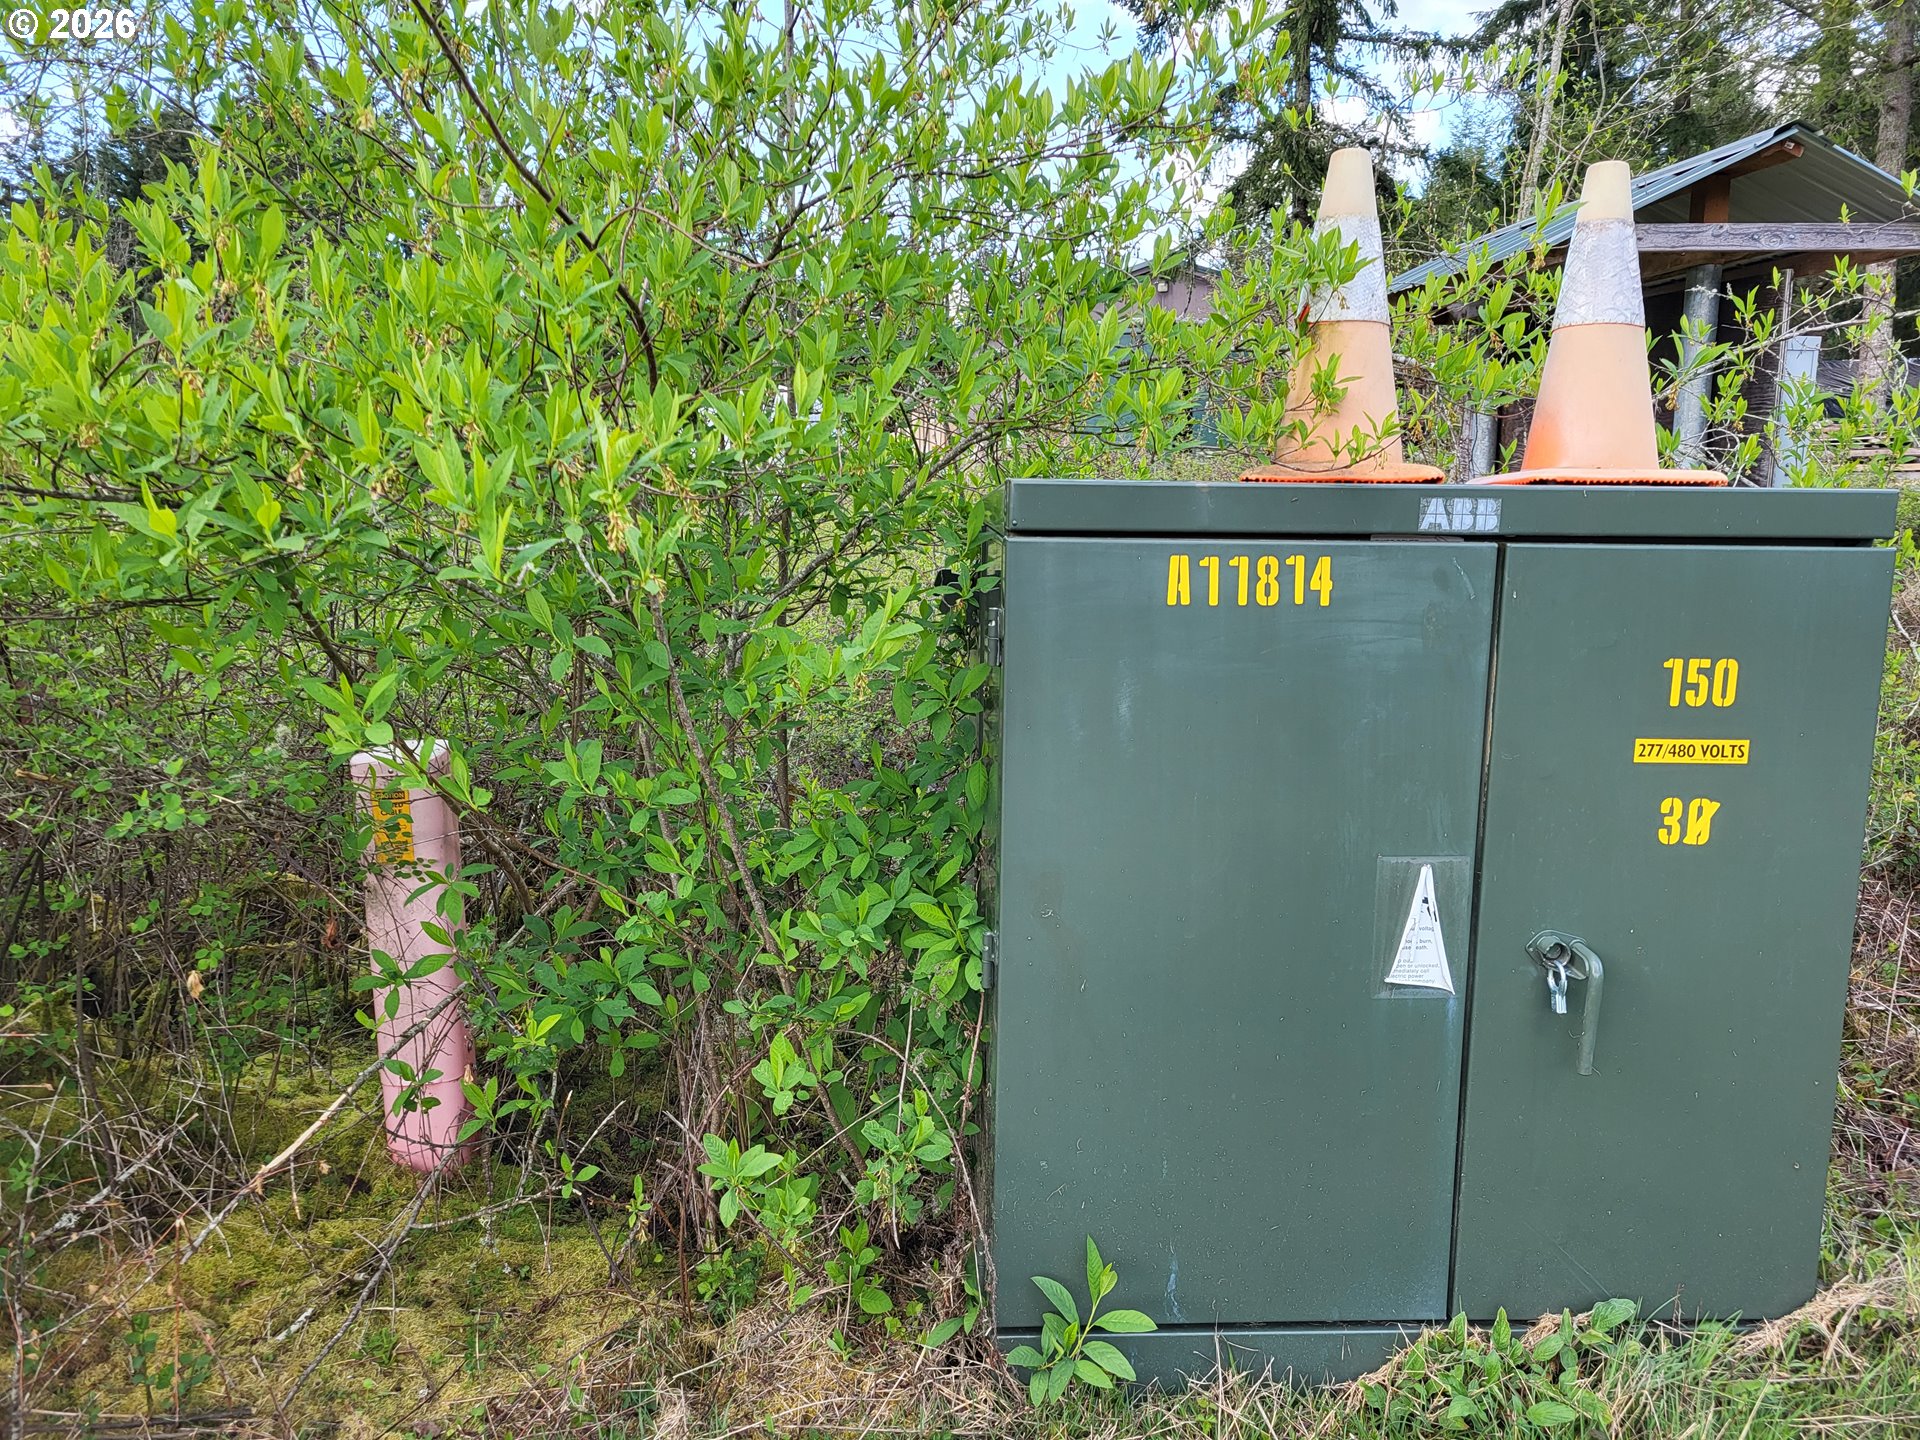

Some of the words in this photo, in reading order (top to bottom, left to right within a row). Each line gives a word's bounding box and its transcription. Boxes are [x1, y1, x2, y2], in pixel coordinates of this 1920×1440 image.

[1419, 497, 1498, 531] ABB
[1165, 554, 1334, 607] A11814
[1663, 657, 1739, 708] 150
[1638, 743, 1697, 759] 277/480
[1700, 744, 1746, 759] VOLTS
